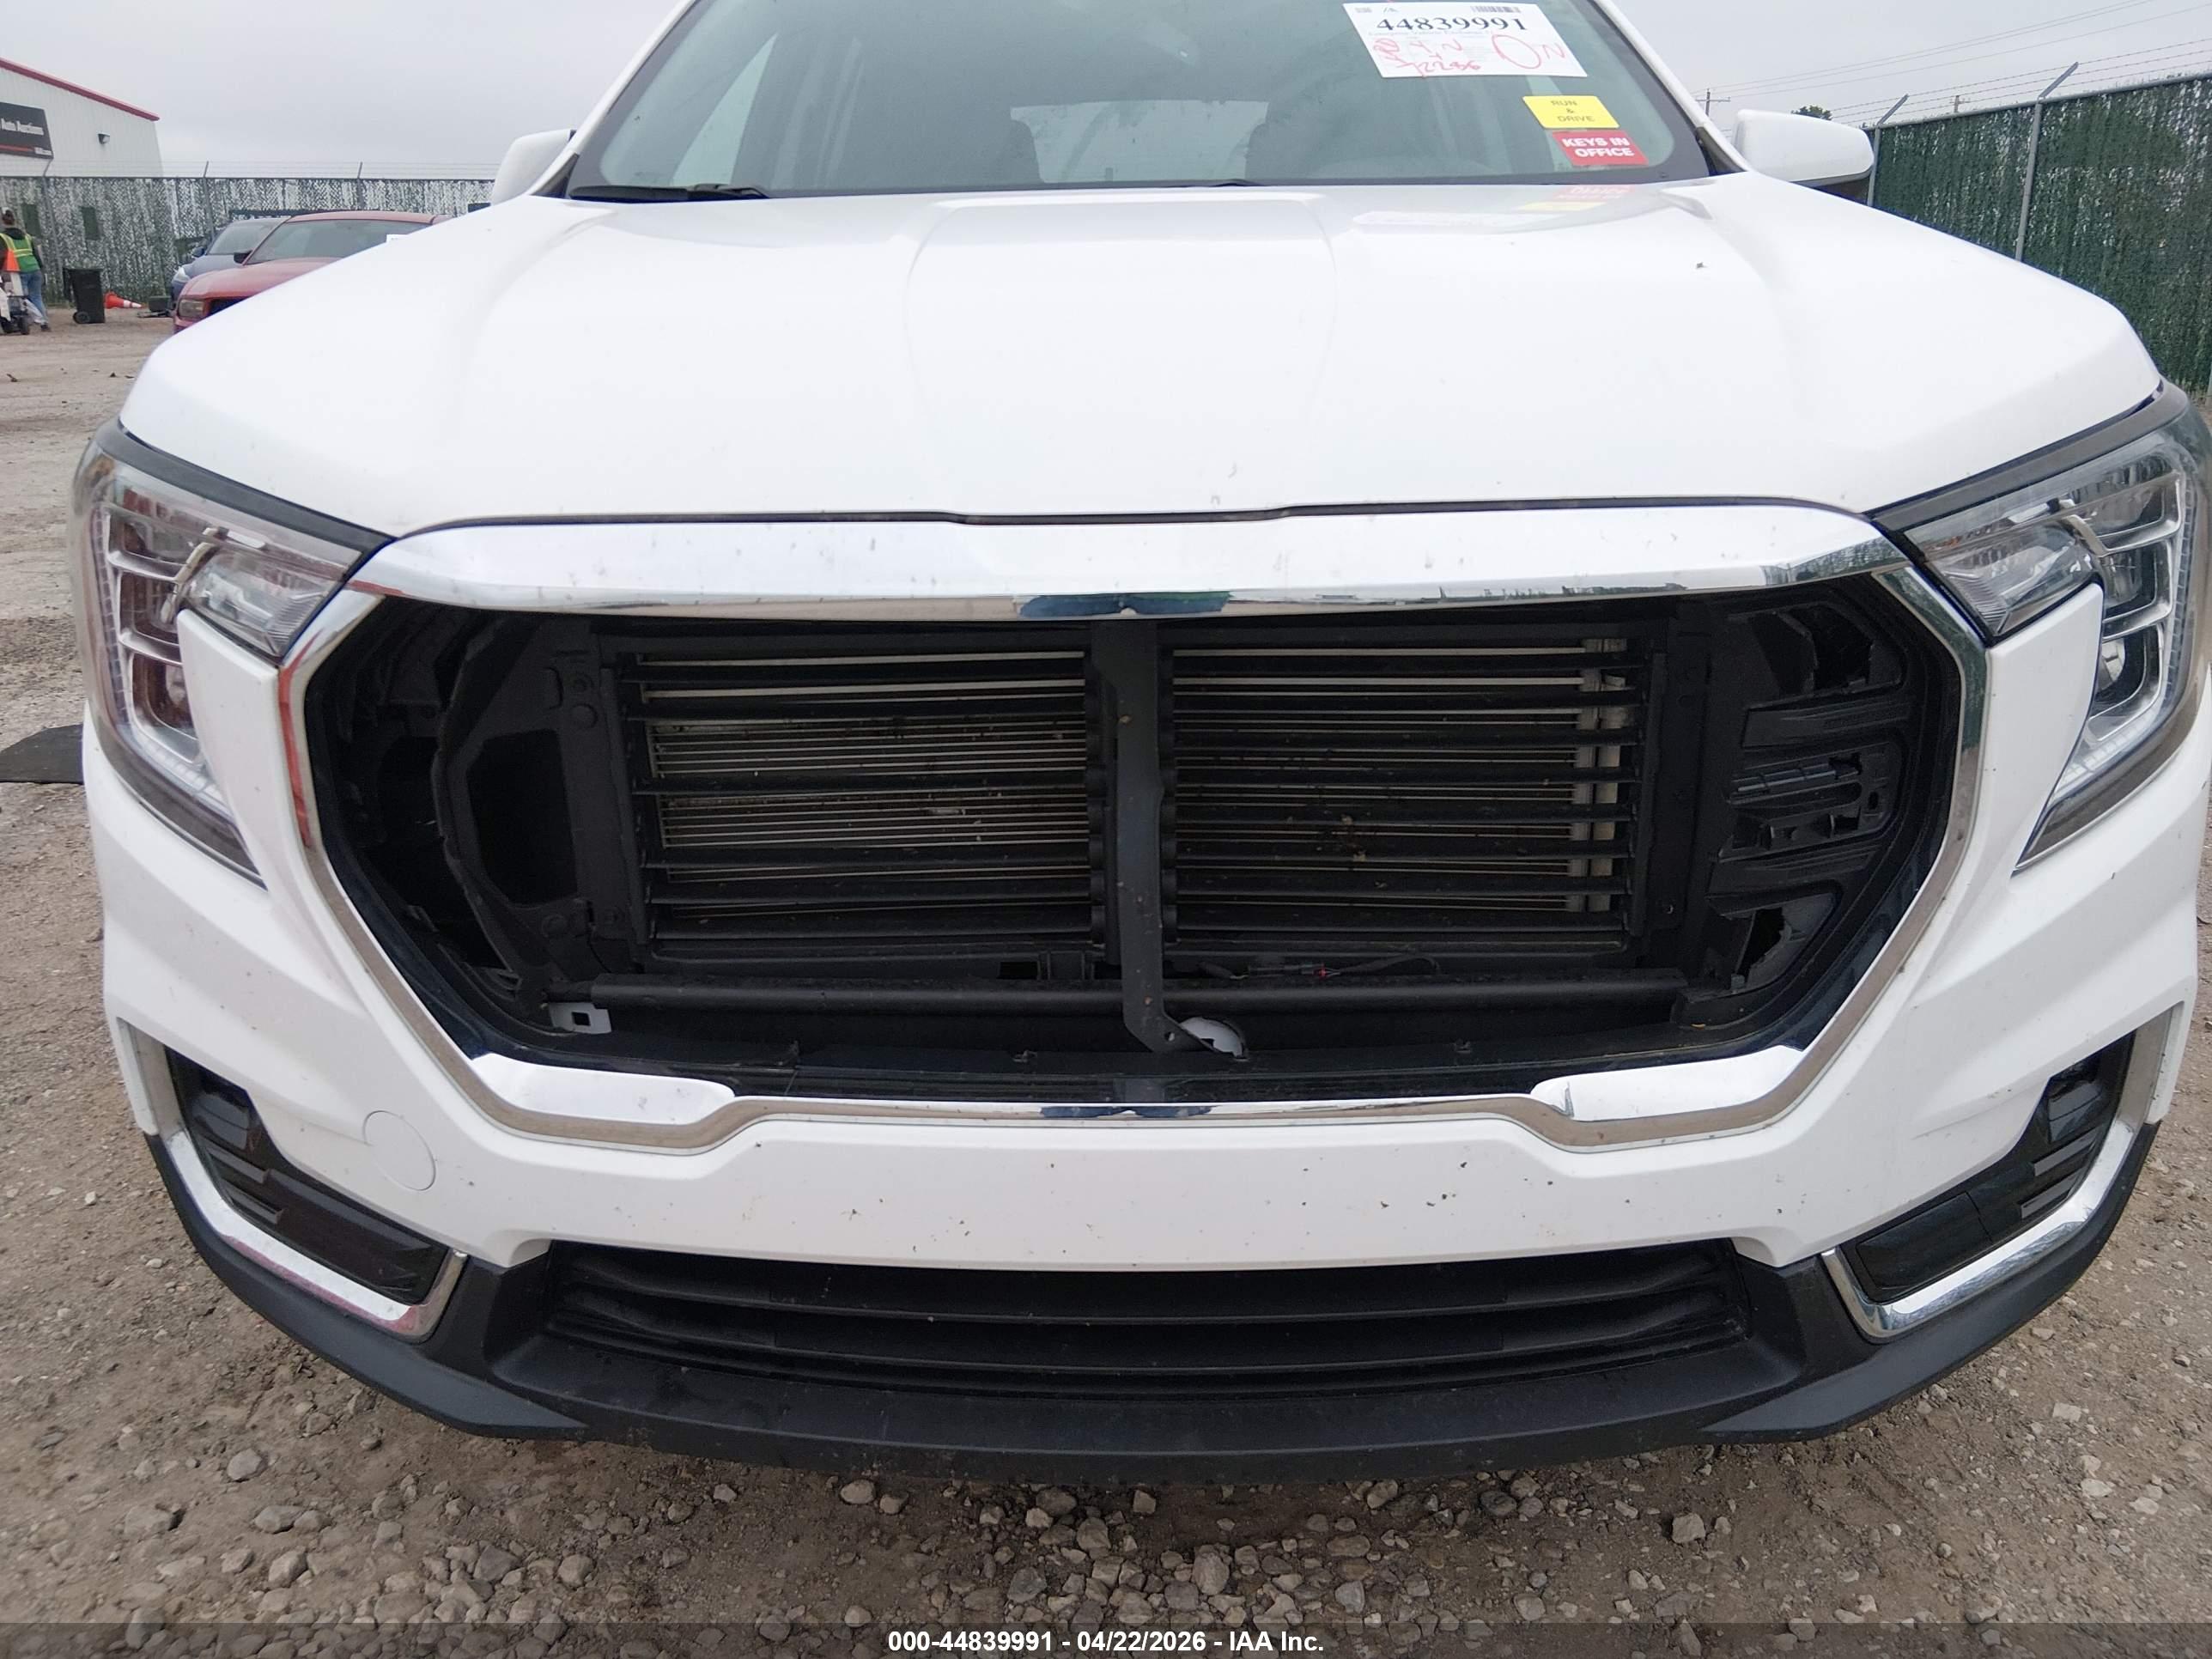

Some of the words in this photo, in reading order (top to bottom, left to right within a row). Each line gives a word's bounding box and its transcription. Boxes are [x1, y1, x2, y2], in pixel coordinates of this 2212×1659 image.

[1376, 17, 1528, 31] 44839991
[1561, 137, 1608, 148] KEYS
[1609, 137, 1631, 146] IN
[1574, 148, 1636, 157] OFFICE
